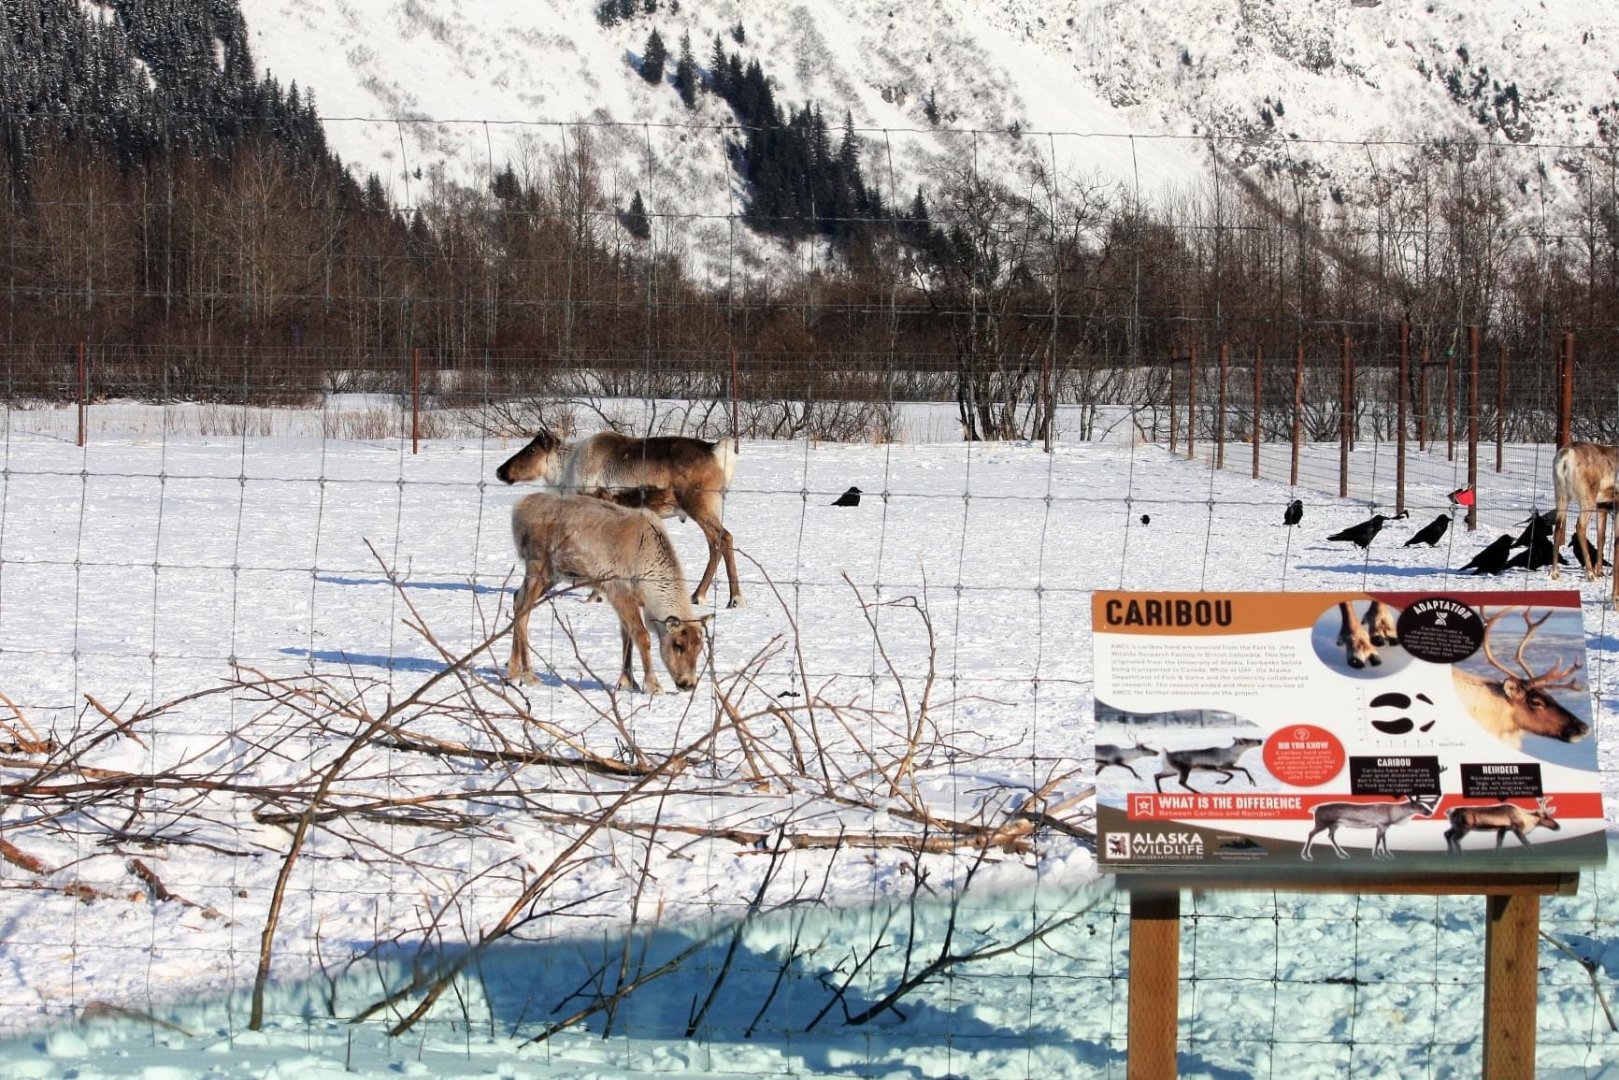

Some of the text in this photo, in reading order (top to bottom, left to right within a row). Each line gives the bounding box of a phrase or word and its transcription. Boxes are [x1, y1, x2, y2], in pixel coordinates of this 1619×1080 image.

[1106, 599, 1232, 626] CARIBOU
[1413, 601, 1472, 619] ADAPTATION
[1377, 758, 1411, 767] CARIBOU
[1482, 766, 1519, 774] REINDEER
[1158, 797, 1302, 809] WHAT IS THE DIFFERENCE
[1132, 832, 1204, 844] ALASKA
[1132, 845, 1204, 855] WILDLIFE
